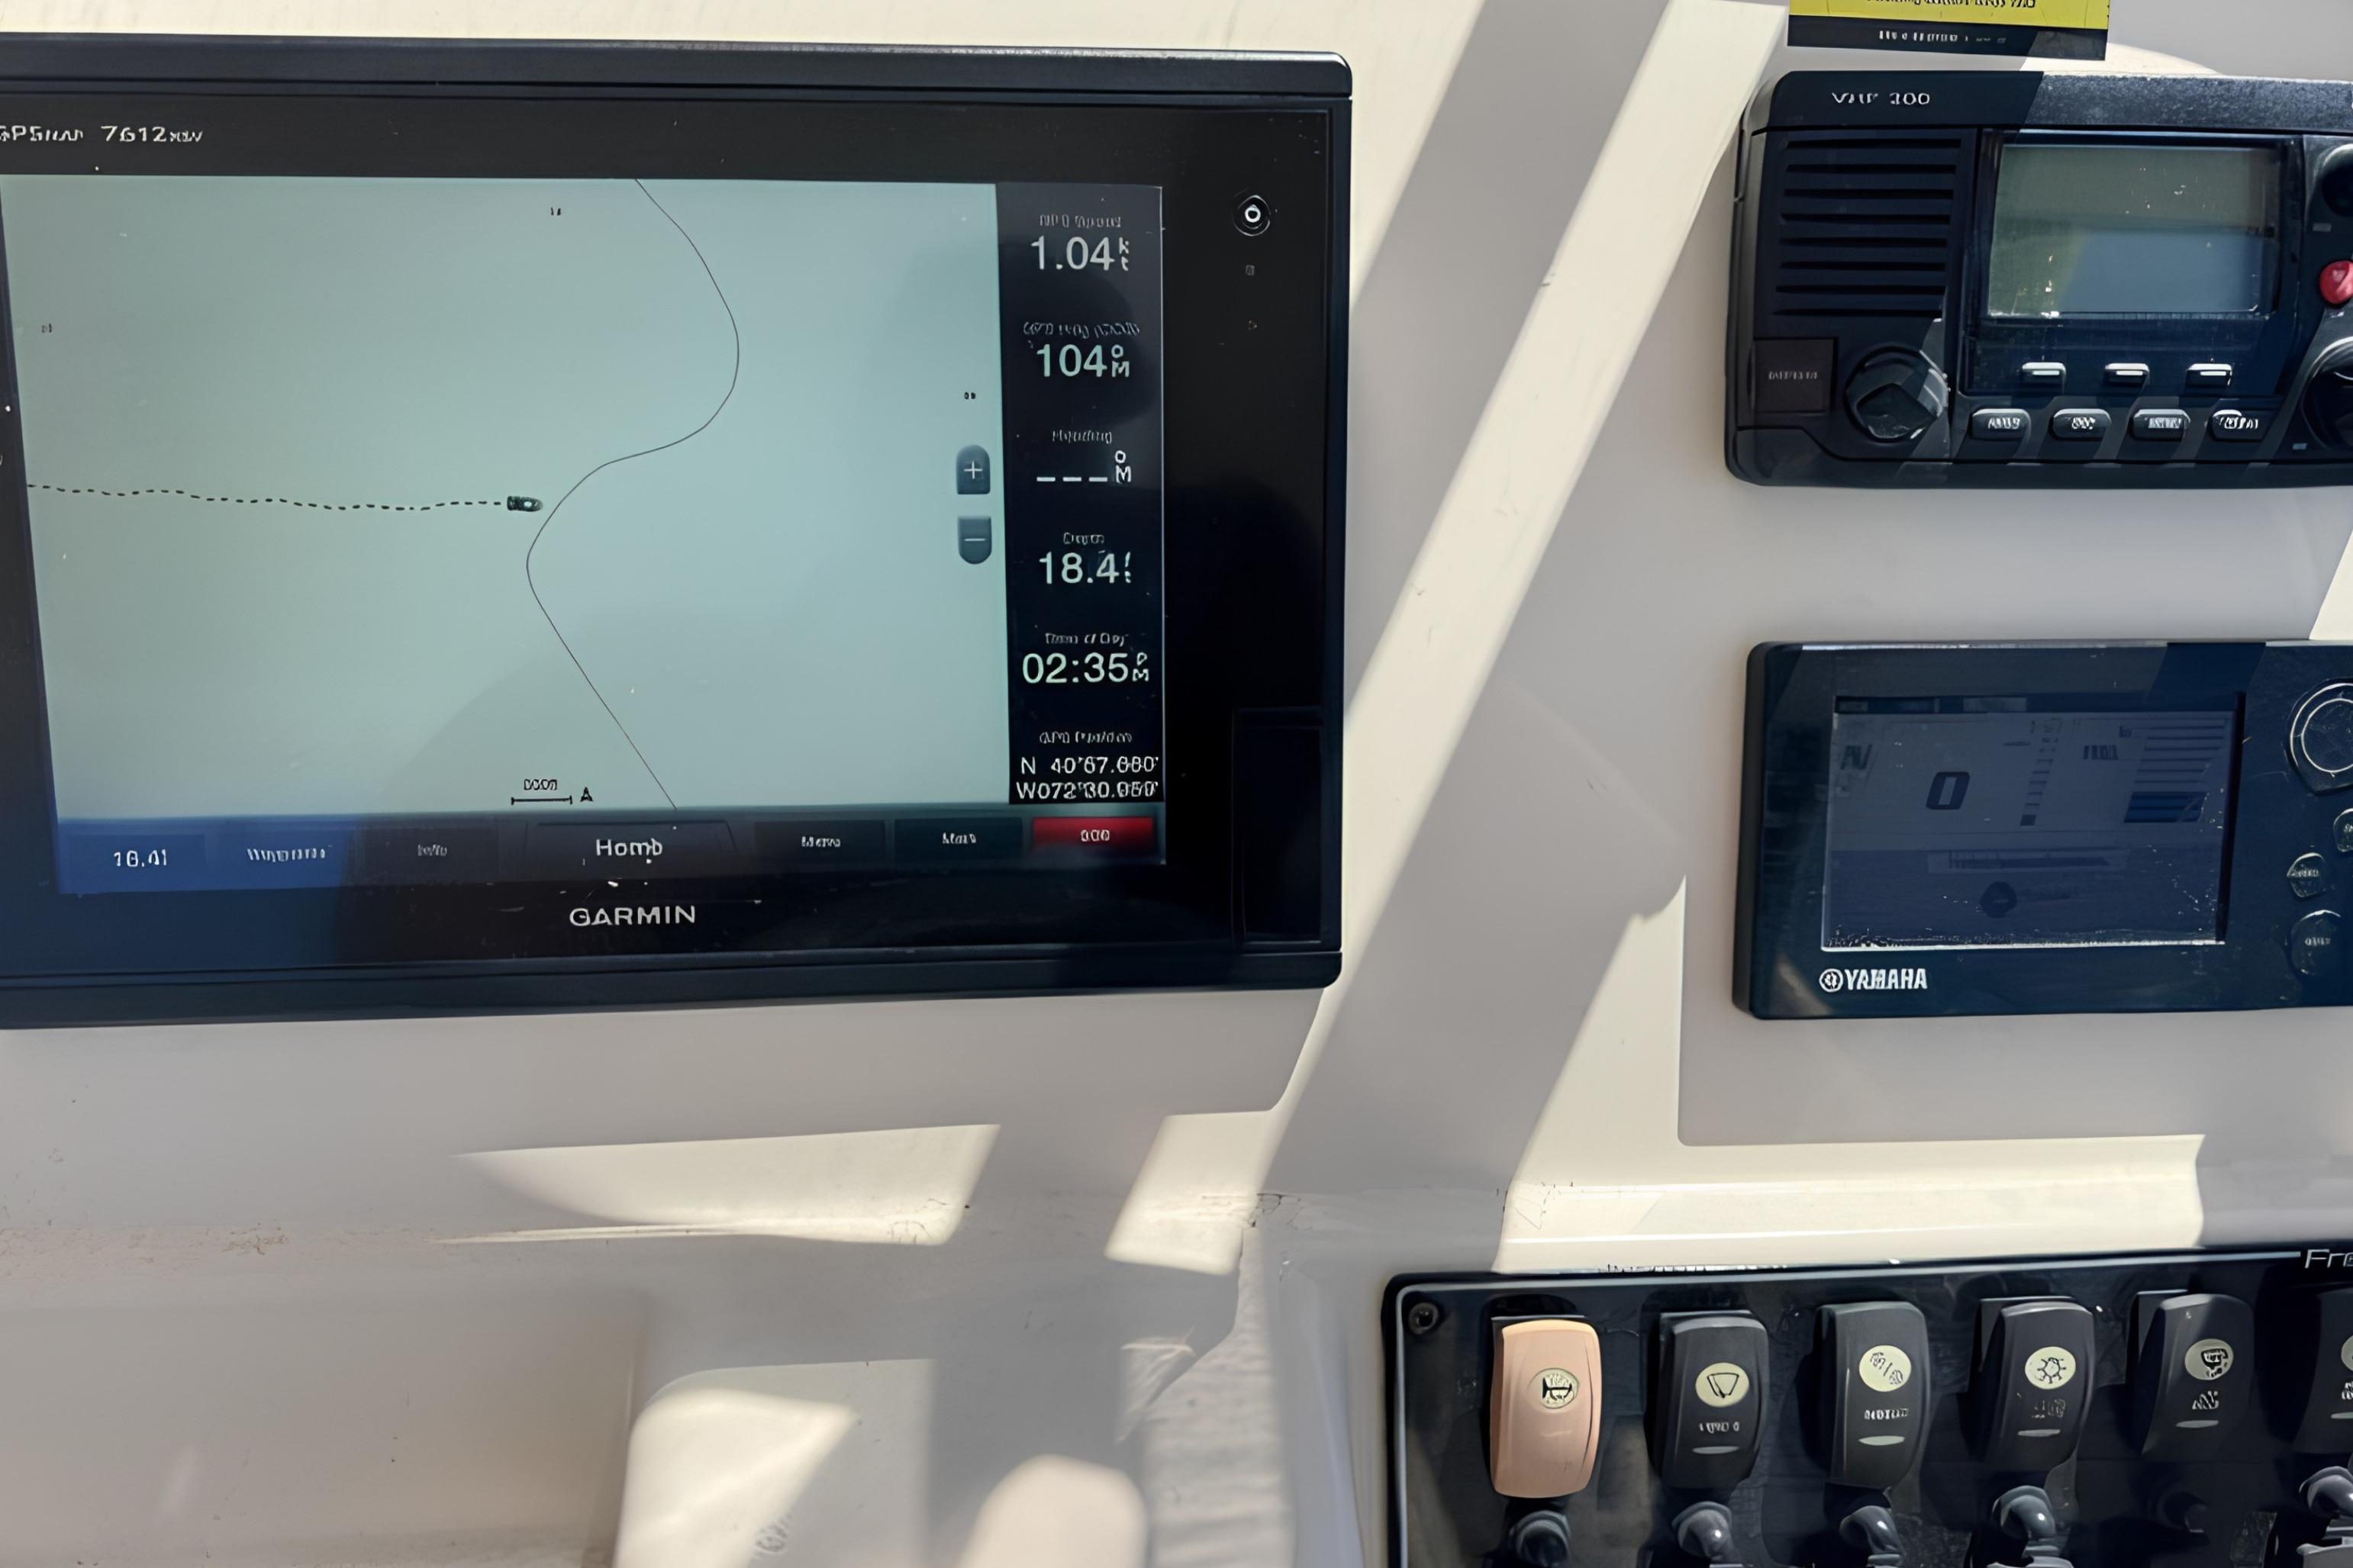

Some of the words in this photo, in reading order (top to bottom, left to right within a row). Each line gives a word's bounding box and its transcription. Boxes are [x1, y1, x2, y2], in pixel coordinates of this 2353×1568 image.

[1031, 236, 1115, 271] 1.04
[1036, 344, 1107, 378] 104
[1039, 551, 1120, 584] 18.4
[1023, 652, 1129, 684] 02:35
[569, 905, 695, 926] GARMIN
[1844, 968, 1928, 990] YAMAHA
